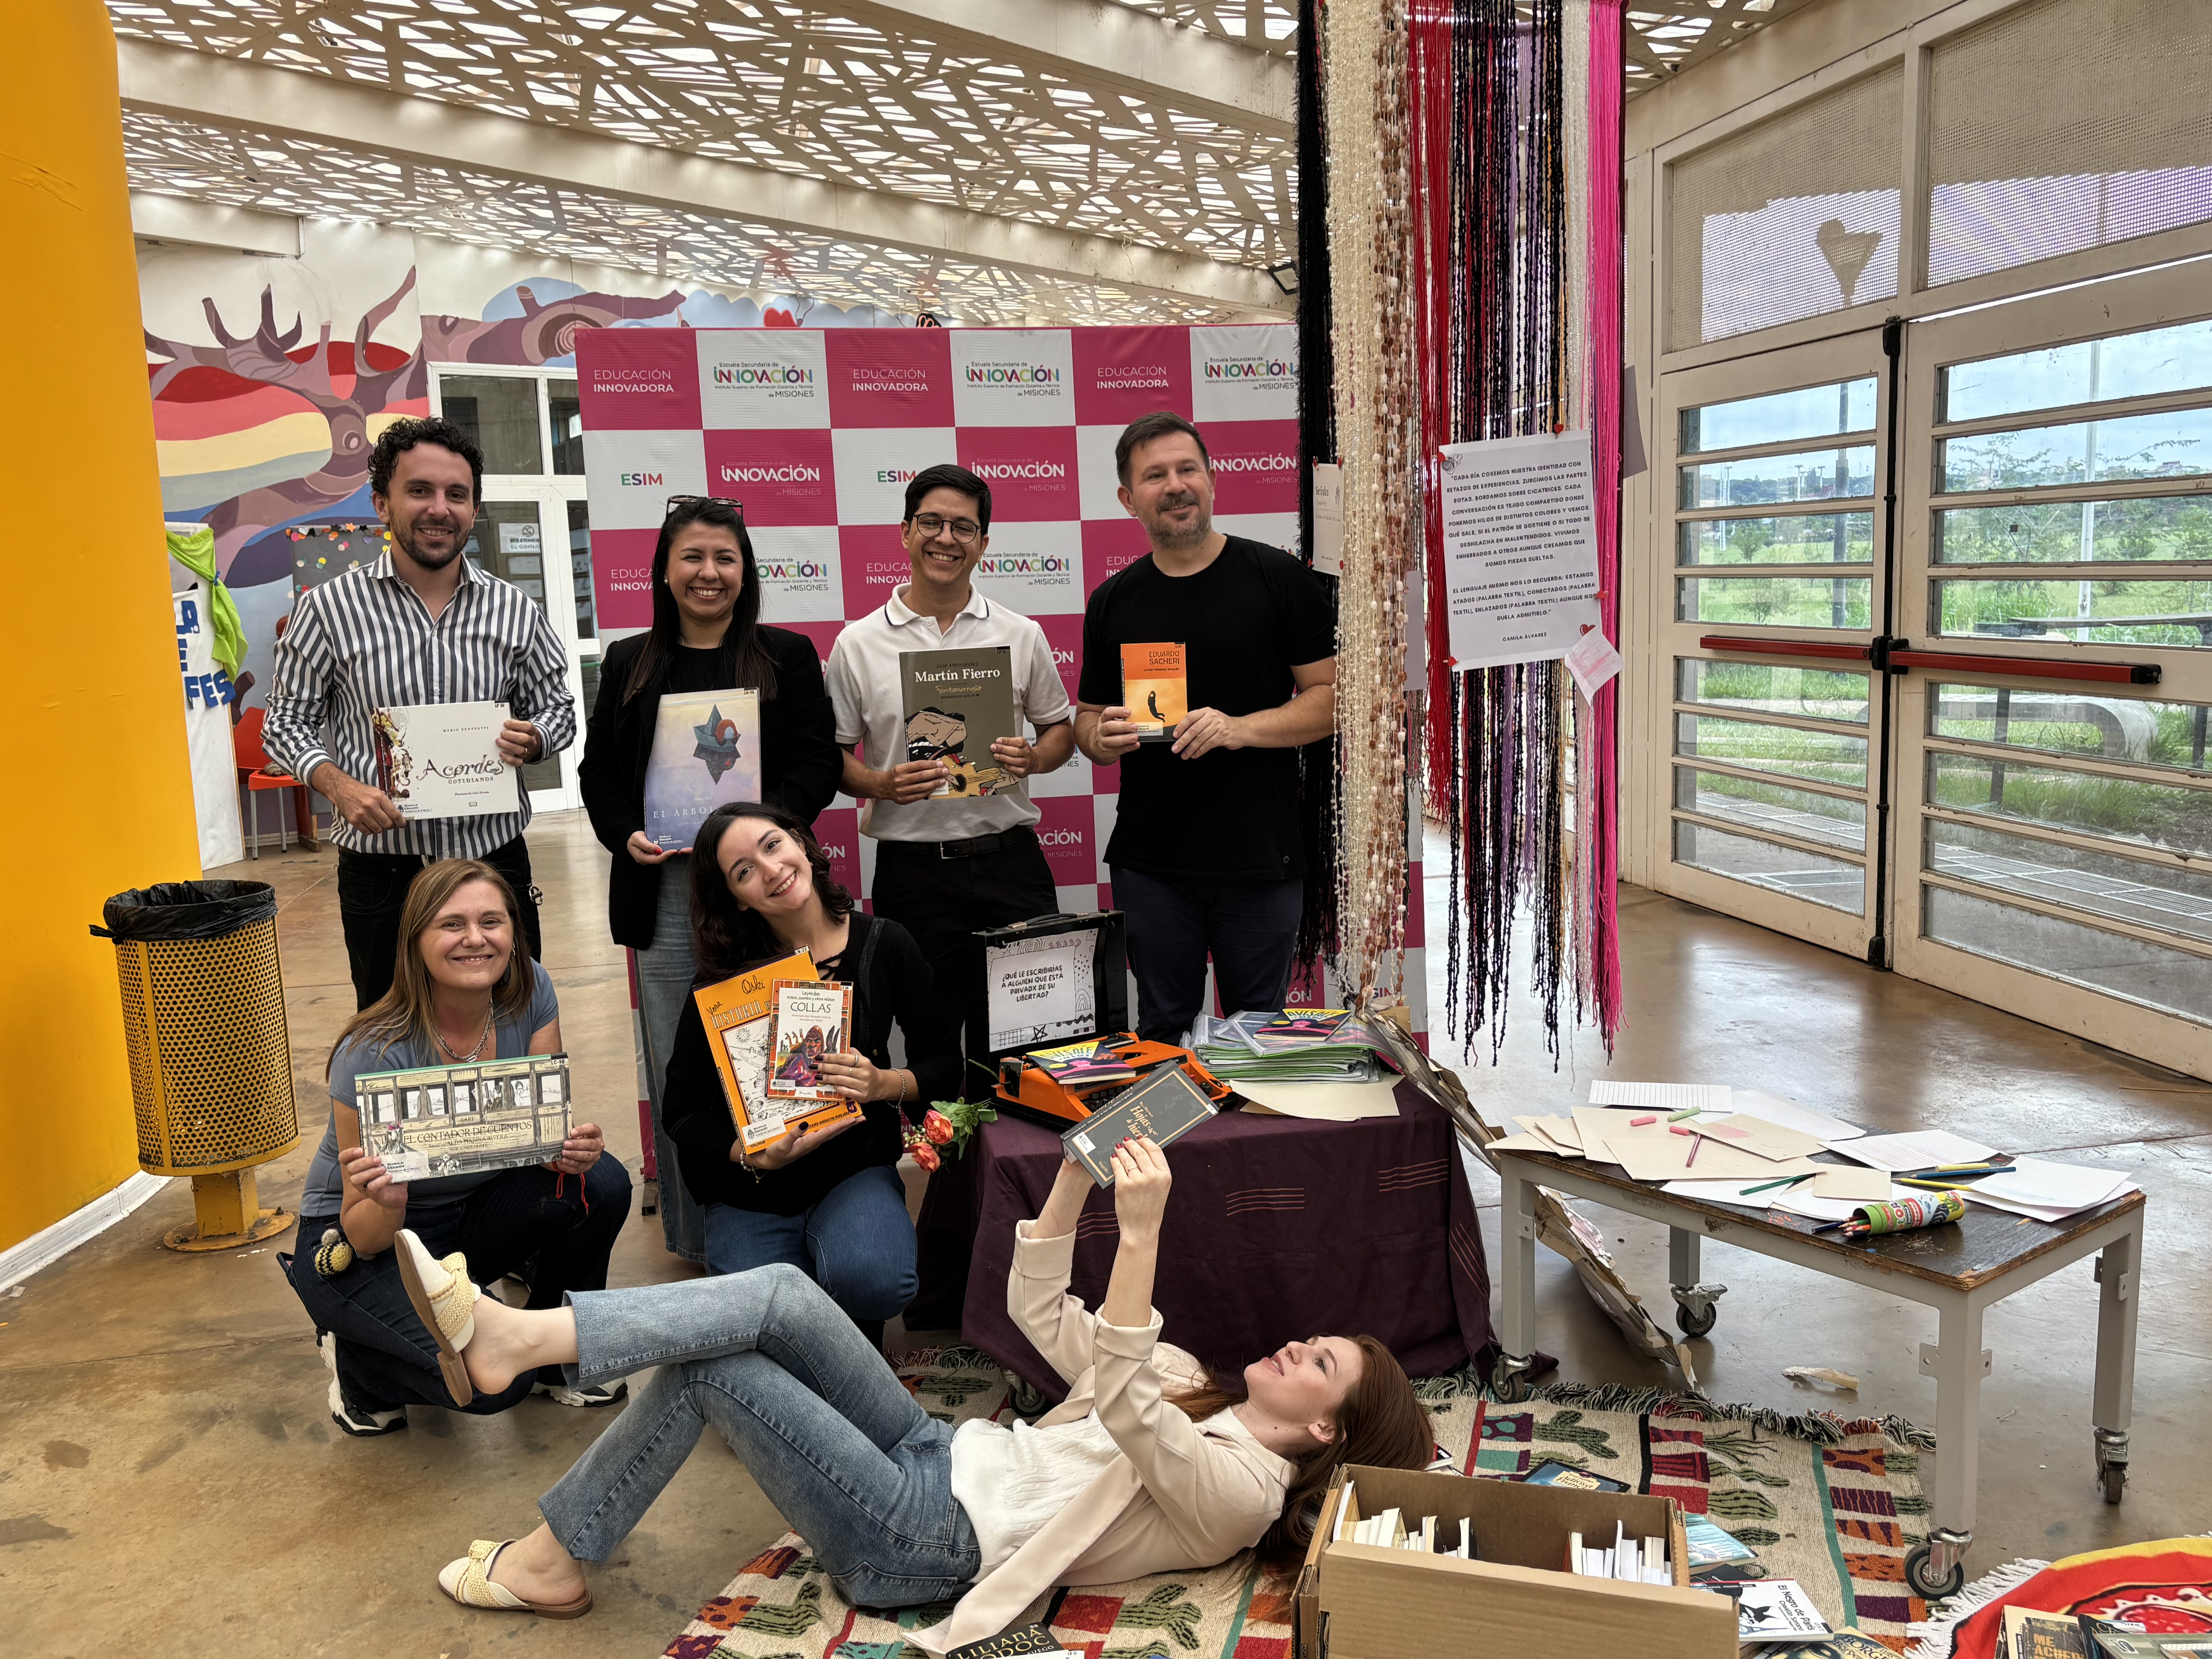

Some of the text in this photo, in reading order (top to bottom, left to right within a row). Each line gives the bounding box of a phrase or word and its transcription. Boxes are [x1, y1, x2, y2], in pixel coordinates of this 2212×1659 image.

[594, 368, 671, 380] EDUCACIÓN
[853, 367, 926, 379] EDUCACIÓN
[1097, 364, 1167, 377] EDUCACIÓN
[593, 383, 674, 393] INNOVADORA
[852, 383, 929, 392] INNOVADORA
[1097, 379, 1169, 389] INNOVADORA
[621, 473, 663, 486] ESIM
[877, 470, 917, 483] ESIM
[782, 488, 822, 496] MISIONES
[1029, 484, 1066, 492] MISIONES
[914, 668, 1001, 683] Martín Fierro
[935, 685, 982, 695] Fontanarrosa
[415, 754, 505, 781] Acordes
[448, 776, 494, 785] COTIDIANOS
[653, 811, 666, 819] EL
[1002, 970, 1017, 982] ¿QUÉ
[1026, 964, 1062, 977] ESCRIBIRÍAS
[1007, 977, 1033, 988] ALGUIEN
[1034, 975, 1047, 984] QUE
[1049, 971, 1064, 981] ESTÁ
[741, 974, 766, 994] Oski
[1010, 985, 1037, 995] PRIVADX
[1016, 991, 1049, 1002] LIBERTAD?
[790, 1002, 831, 1013] COLLAS
[710, 1000, 763, 1030] HISTORIA
[1130, 1105, 1151, 1127] Hojas
[404, 1121, 532, 1144] EL CONTADOR DE CUENTOS
[1127, 1122, 1148, 1137] hier
[1781, 1591, 1798, 1608] Negro
[2033, 1633, 2054, 1647] ME
